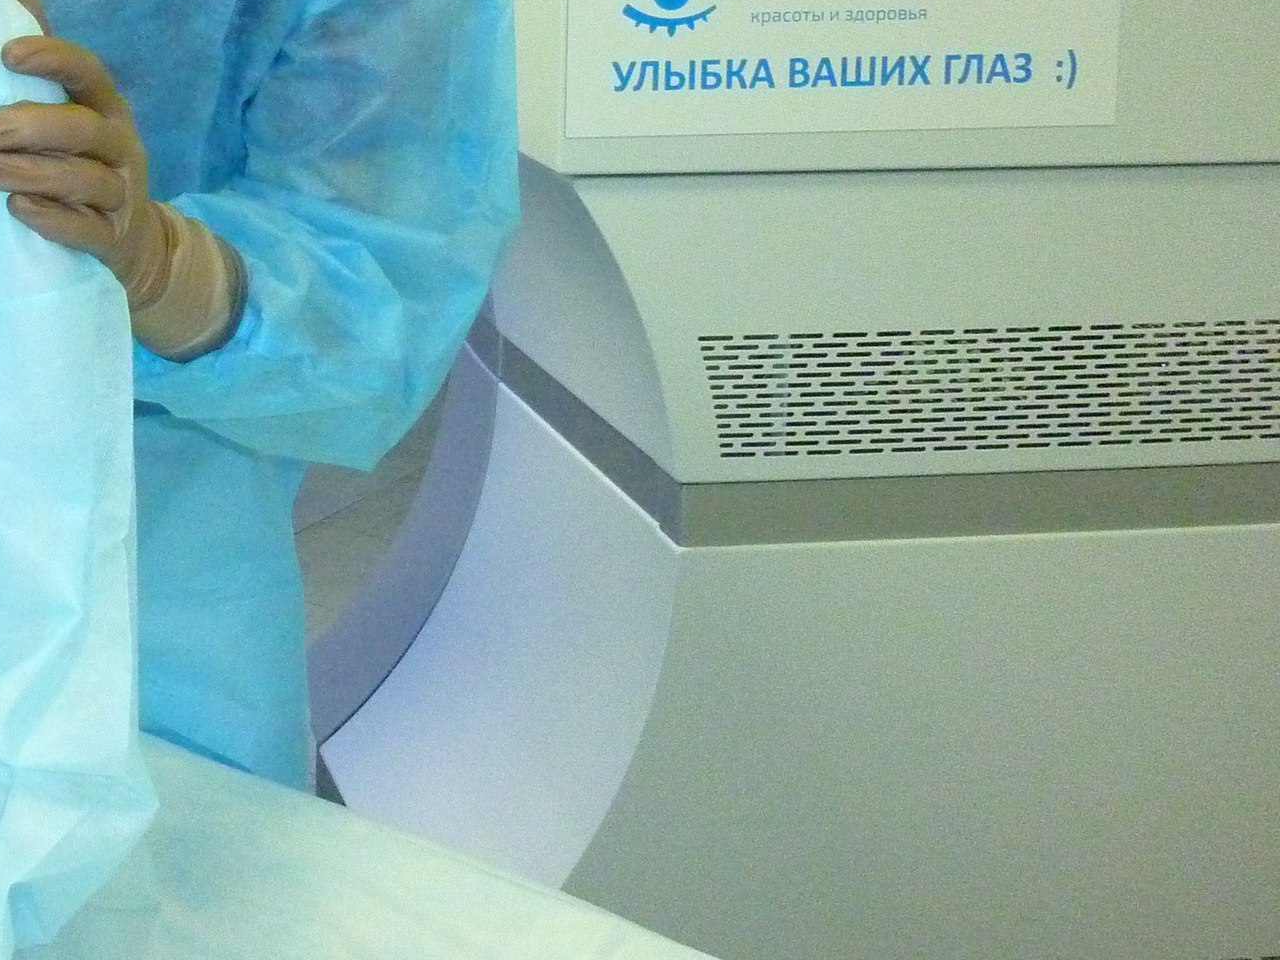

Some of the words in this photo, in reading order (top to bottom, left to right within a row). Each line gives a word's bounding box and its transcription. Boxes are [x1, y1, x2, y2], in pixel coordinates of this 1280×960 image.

[750, 9, 824, 26] красоты
[829, 10, 840, 22] и
[844, 6, 928, 25] здоровья
[611, 58, 775, 93] УЛЫБКА
[789, 54, 931, 88] ВАШИХ
[943, 52, 1034, 87] ГЛАЗ
